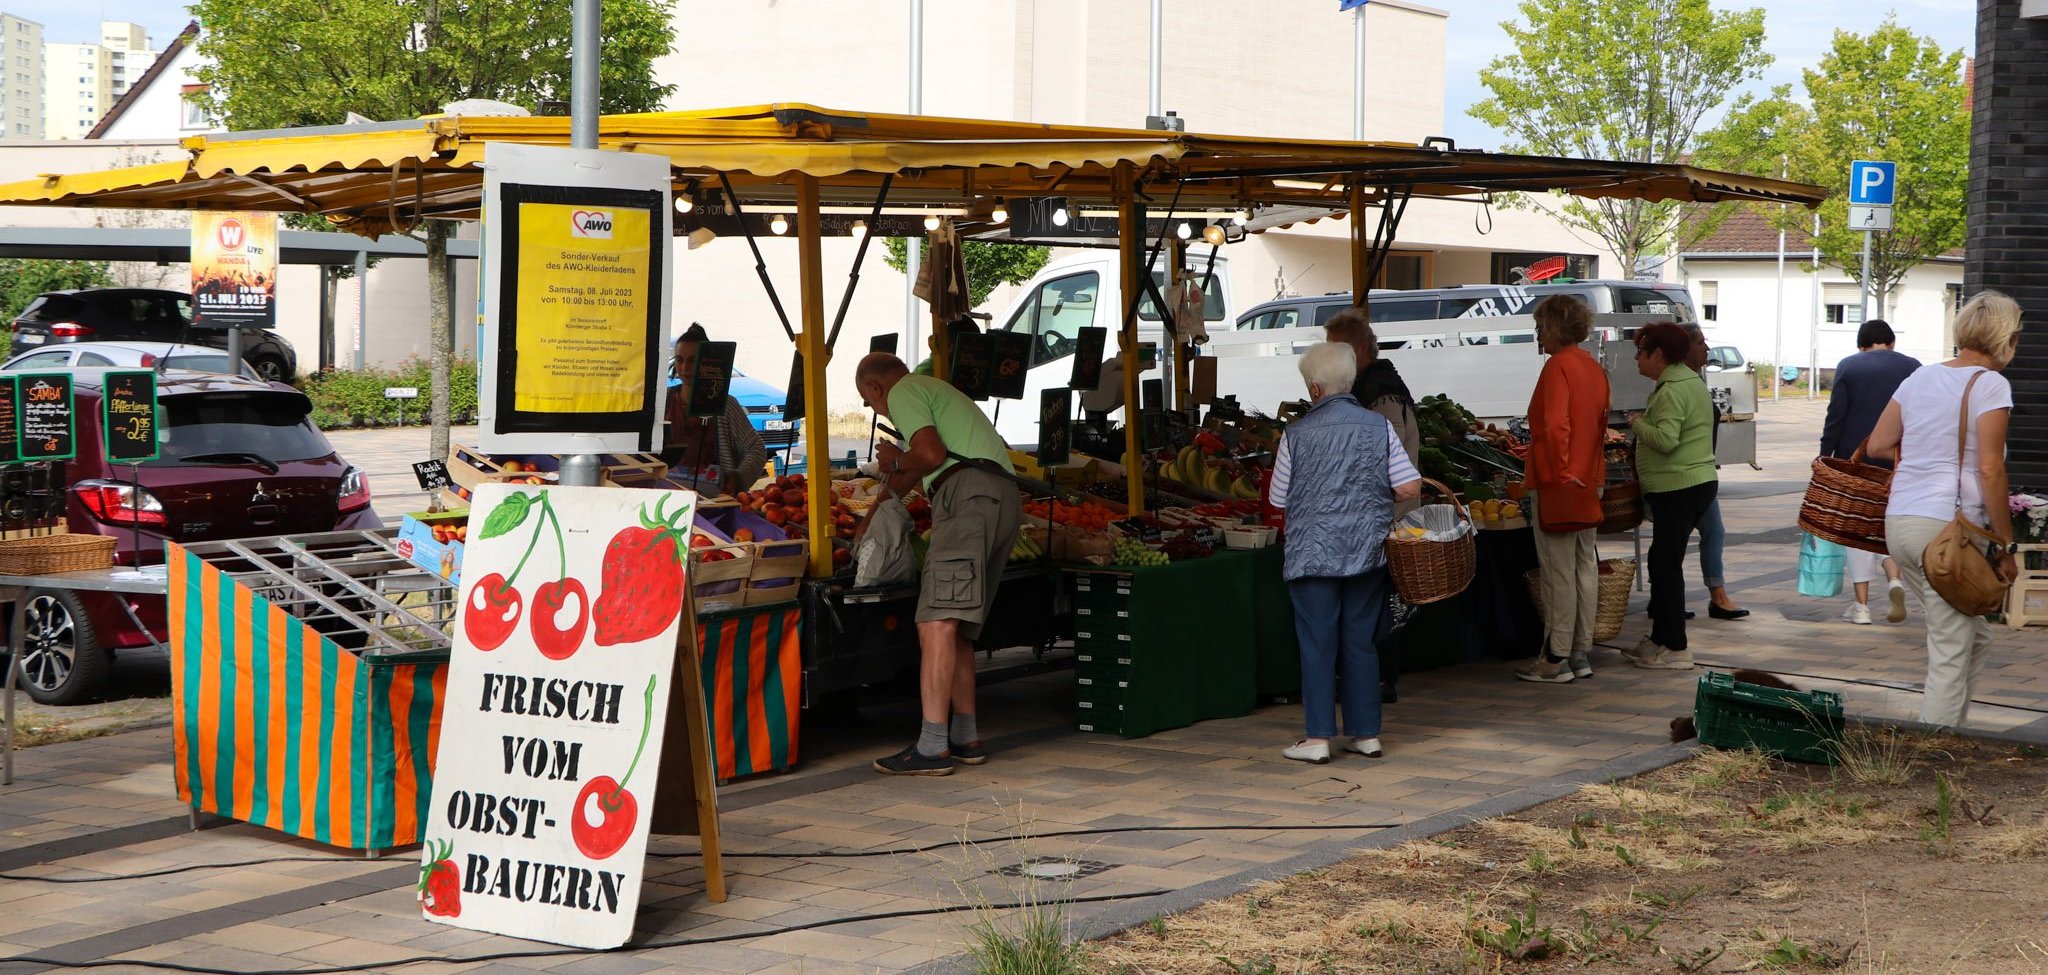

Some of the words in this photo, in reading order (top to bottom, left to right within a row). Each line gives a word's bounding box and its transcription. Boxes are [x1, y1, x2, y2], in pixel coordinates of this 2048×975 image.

[1861, 167, 1885, 198] P
[583, 220, 612, 232] AWO
[221, 226, 241, 245] W
[247, 245, 264, 255] LIVE!
[560, 251, 620, 263] Sonder-Verkauf
[546, 262, 561, 270] des
[563, 262, 636, 274] AWO-Kleiderladens
[548, 285, 585, 295] Samstag,
[587, 287, 597, 295] 08.
[600, 287, 613, 296] Juli
[615, 288, 632, 297] 2023
[217, 294, 237, 304] JULI
[240, 294, 267, 305] 2023
[562, 297, 583, 305] 10:00
[584, 297, 595, 306] bis
[597, 298, 617, 307] 13:00
[479, 673, 624, 724] FRISCH
[502, 735, 583, 782] VOM
[447, 790, 556, 840] OBST-
[462, 853, 626, 914] BAUERN
